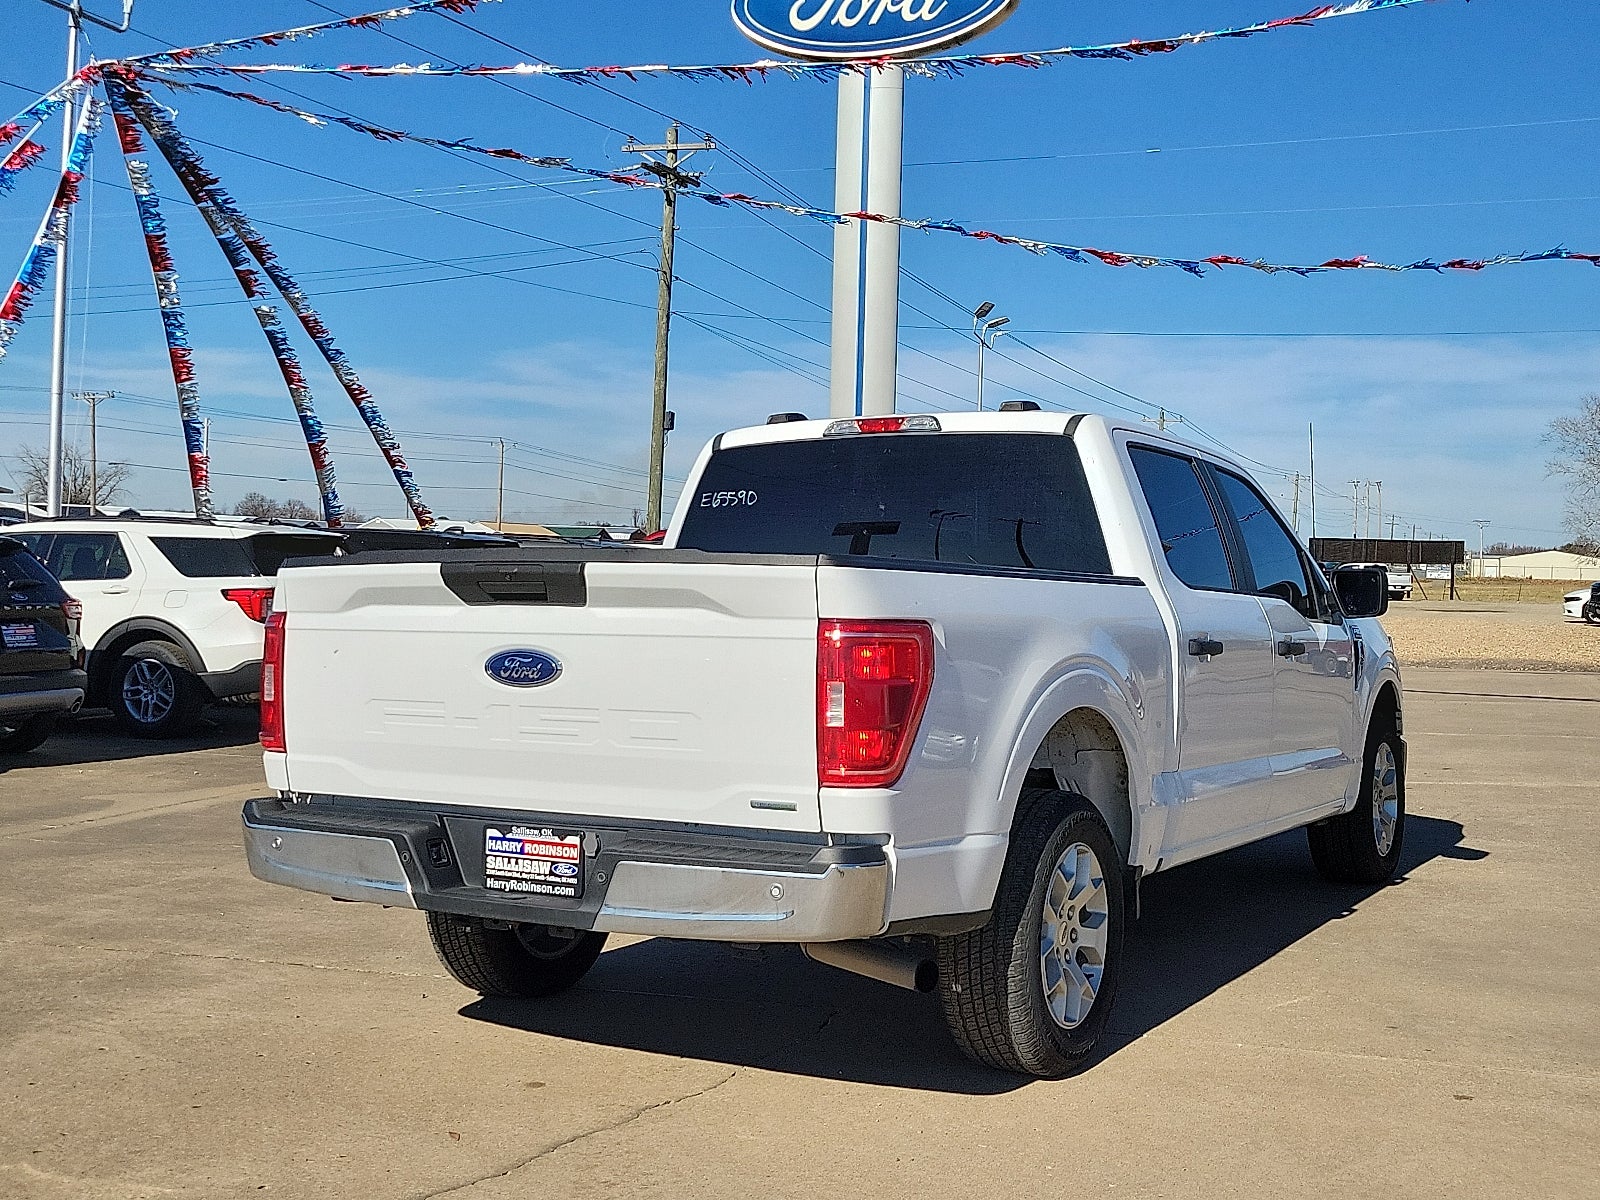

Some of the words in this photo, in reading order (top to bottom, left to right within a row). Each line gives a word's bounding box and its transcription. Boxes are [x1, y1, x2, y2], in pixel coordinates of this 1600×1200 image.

[700, 489, 758, 508] E65590
[500, 656, 543, 679] Ford
[541, 828, 553, 836] OK
[488, 840, 524, 853] HARRY
[524, 843, 578, 859] ROBINSON
[486, 856, 552, 875] SALLISAW
[486, 878, 575, 896] HarryRobinson.com
